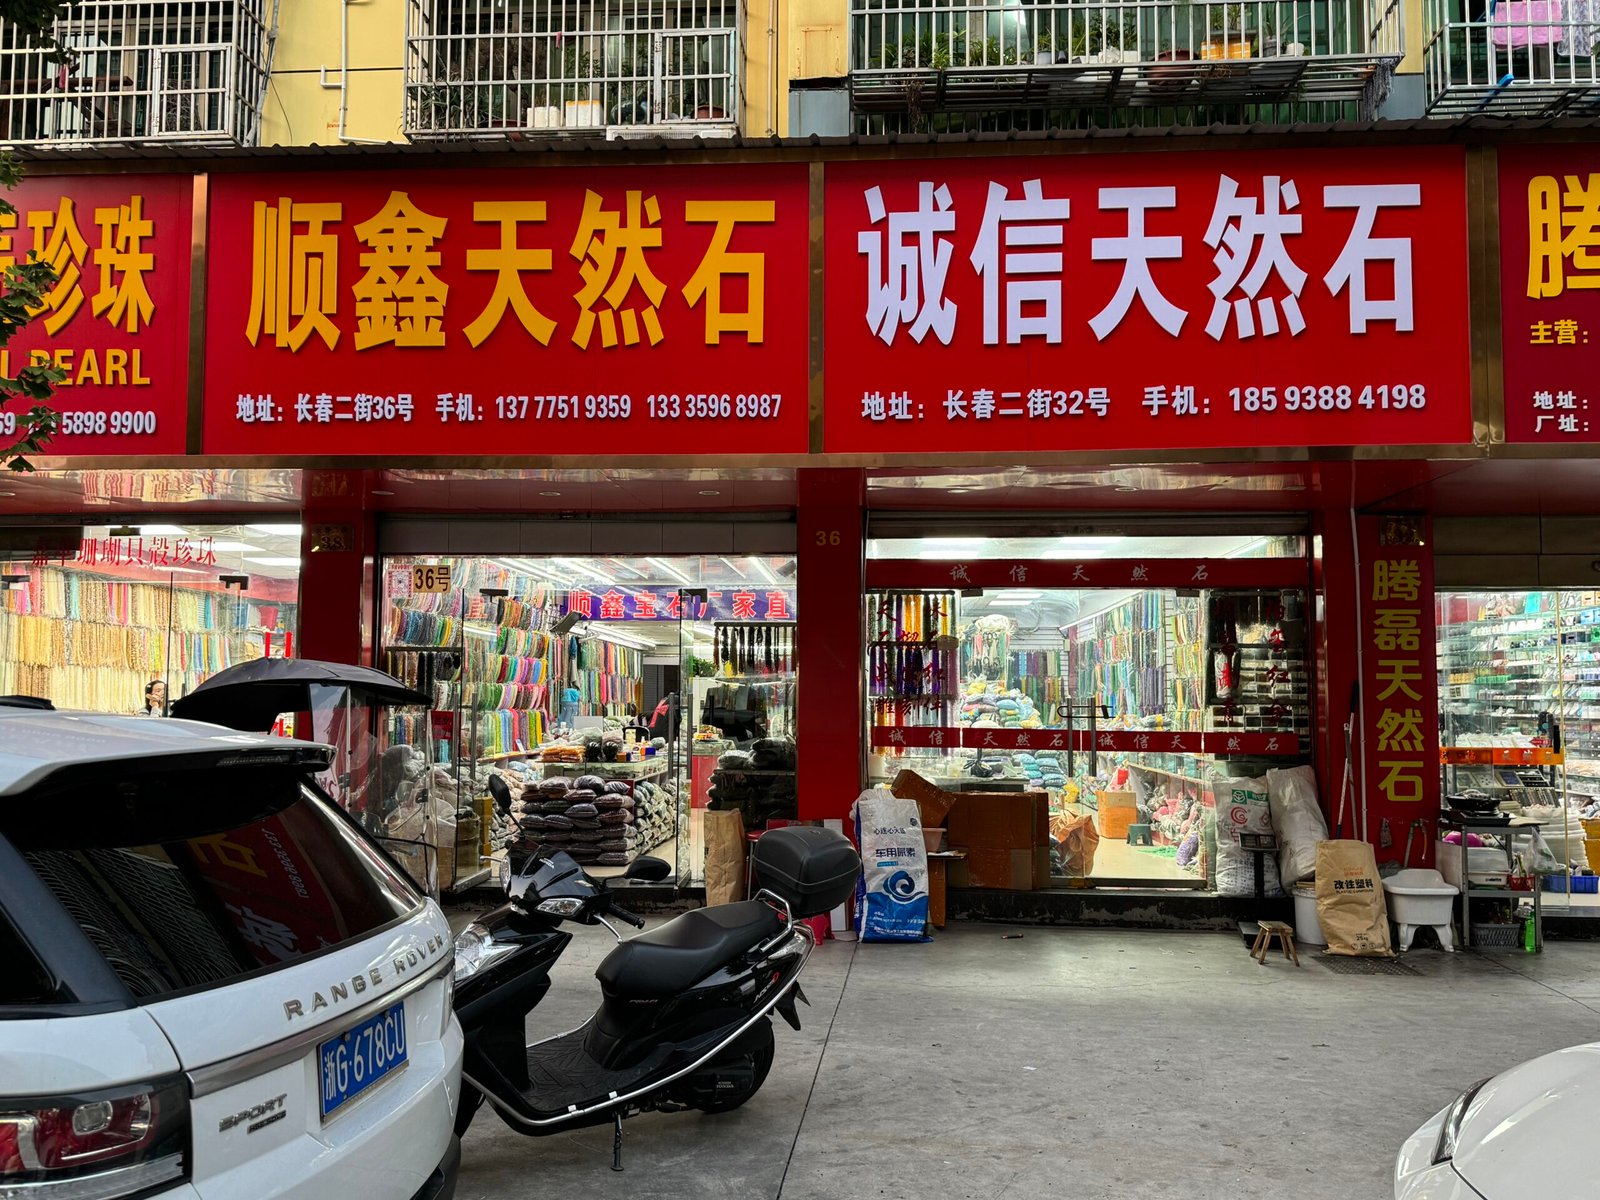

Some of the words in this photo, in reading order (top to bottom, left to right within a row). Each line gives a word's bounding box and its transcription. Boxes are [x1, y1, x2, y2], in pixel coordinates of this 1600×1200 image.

[0, 195, 155, 337] 珍珠
[245, 188, 776, 353] 顺鑫天然石
[858, 174, 1421, 347] 诚信天然石
[495, 395, 529, 419] 137
[534, 395, 579, 418] 7751
[584, 394, 631, 418] 9359
[646, 394, 681, 418] 133
[685, 394, 731, 418] 3596
[735, 394, 781, 417] 8987
[1229, 387, 1278, 411] 185
[1284, 385, 1352, 411] 9388
[1358, 384, 1426, 409] 4198
[62, 411, 107, 434] 5898
[110, 411, 156, 434] 9900
[815, 530, 842, 546] 36
[415, 568, 451, 592] 36号
[1372, 559, 1425, 802] 腾磊天然石
[1333, 878, 1374, 890] 改性塑料
[283, 968, 382, 1020] RANGE
[393, 933, 445, 975] ROVER
[219, 1093, 287, 1132] SPORT
